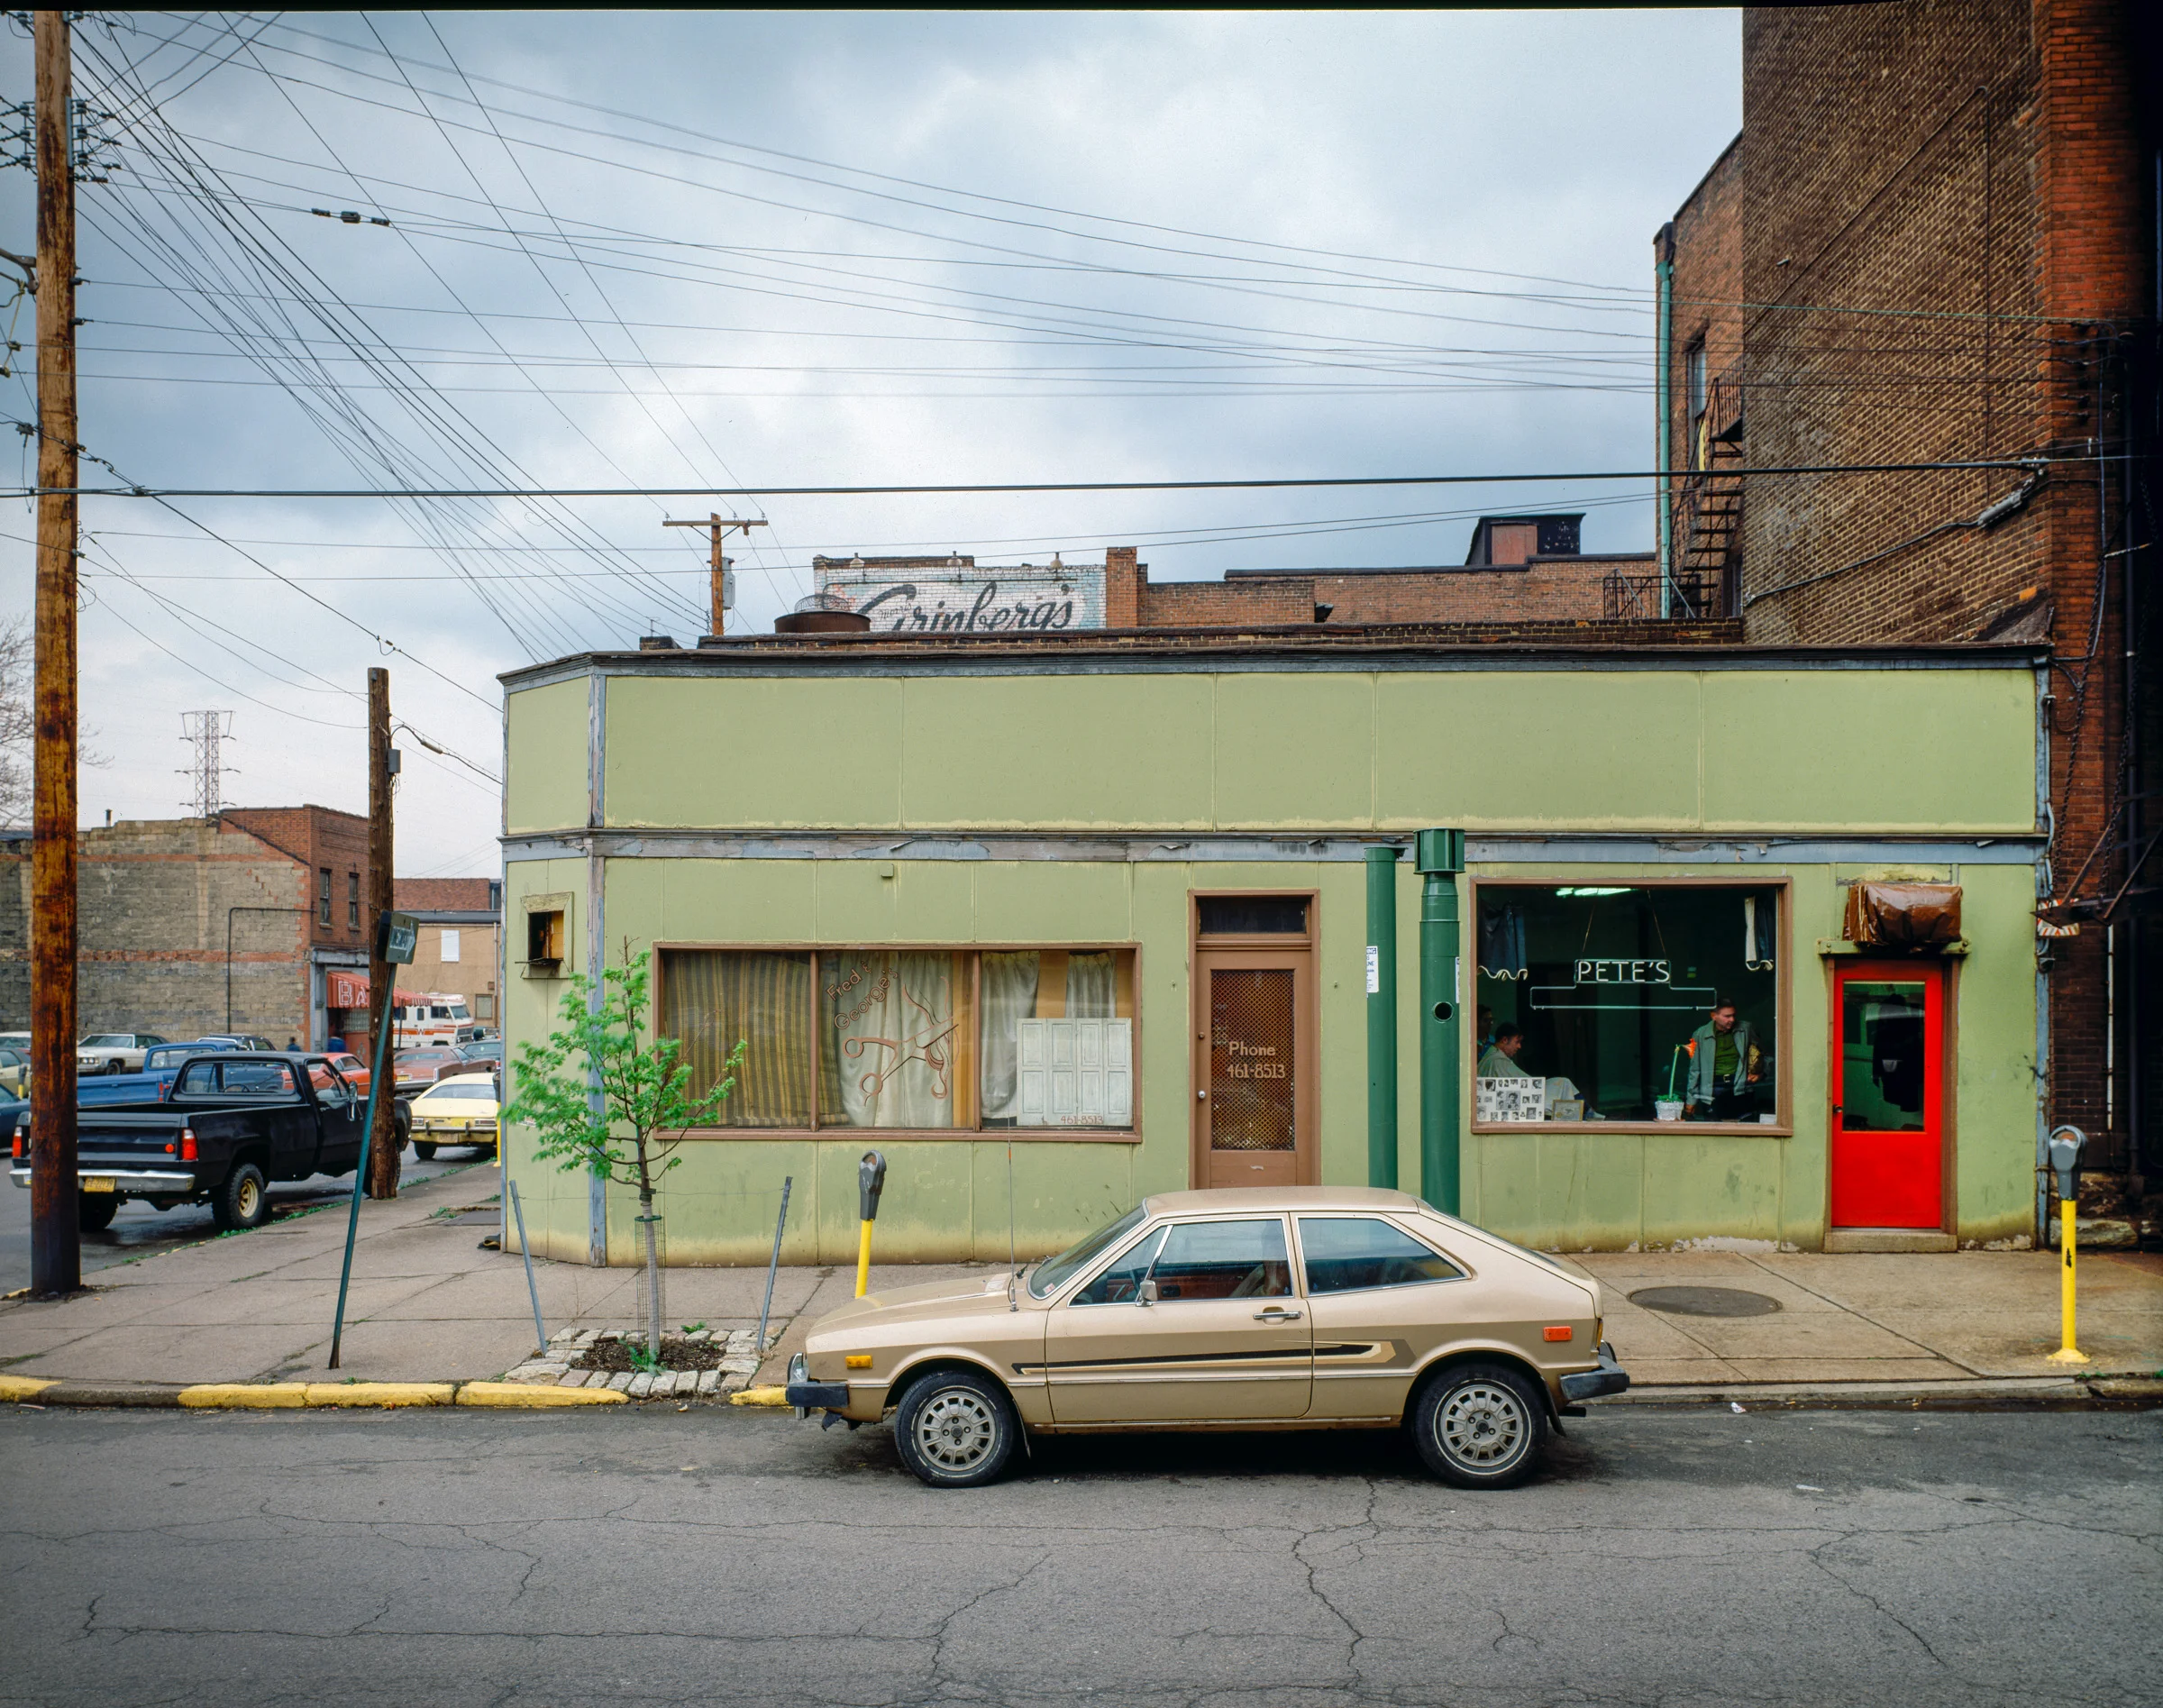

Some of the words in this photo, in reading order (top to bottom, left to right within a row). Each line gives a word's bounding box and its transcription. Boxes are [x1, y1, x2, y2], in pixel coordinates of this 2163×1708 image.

[1577, 961, 1670, 982] PETE'S
[338, 980, 369, 1007] BA
[826, 967, 862, 1002] Fred
[834, 967, 899, 1030] George's
[1228, 1040, 1277, 1056] Phone
[1226, 1064, 1286, 1079] 461-8513
[1060, 1115, 1104, 1126] 461-8513
